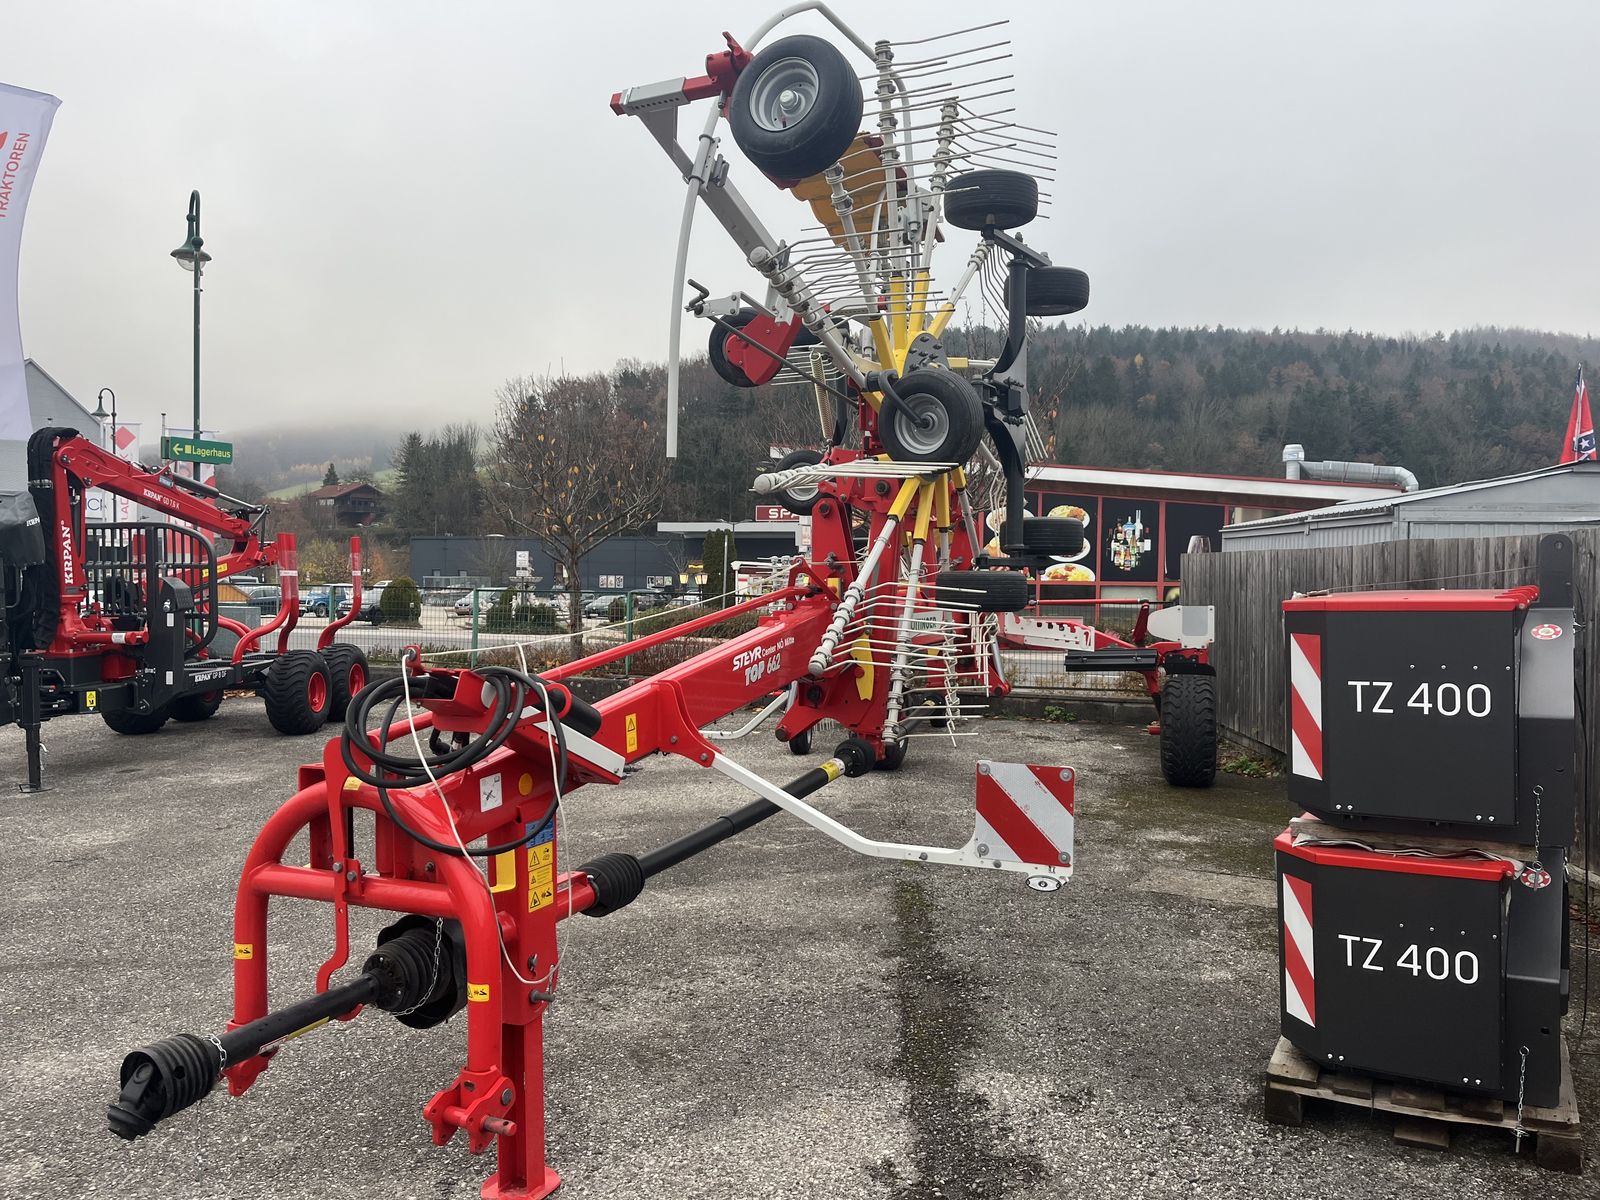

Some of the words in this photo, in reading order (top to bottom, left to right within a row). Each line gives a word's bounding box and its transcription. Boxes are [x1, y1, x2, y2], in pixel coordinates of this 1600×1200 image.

[192, 445, 231, 459] Lagerhaus
[732, 646, 762, 671] STEYR
[762, 645, 777, 657] Center
[744, 660, 765, 687] TOP
[766, 652, 781, 675] 662
[1347, 680, 1394, 713] TZ
[1406, 682, 1492, 718] 400
[1338, 934, 1384, 972] TZ
[1396, 944, 1479, 984] 400
